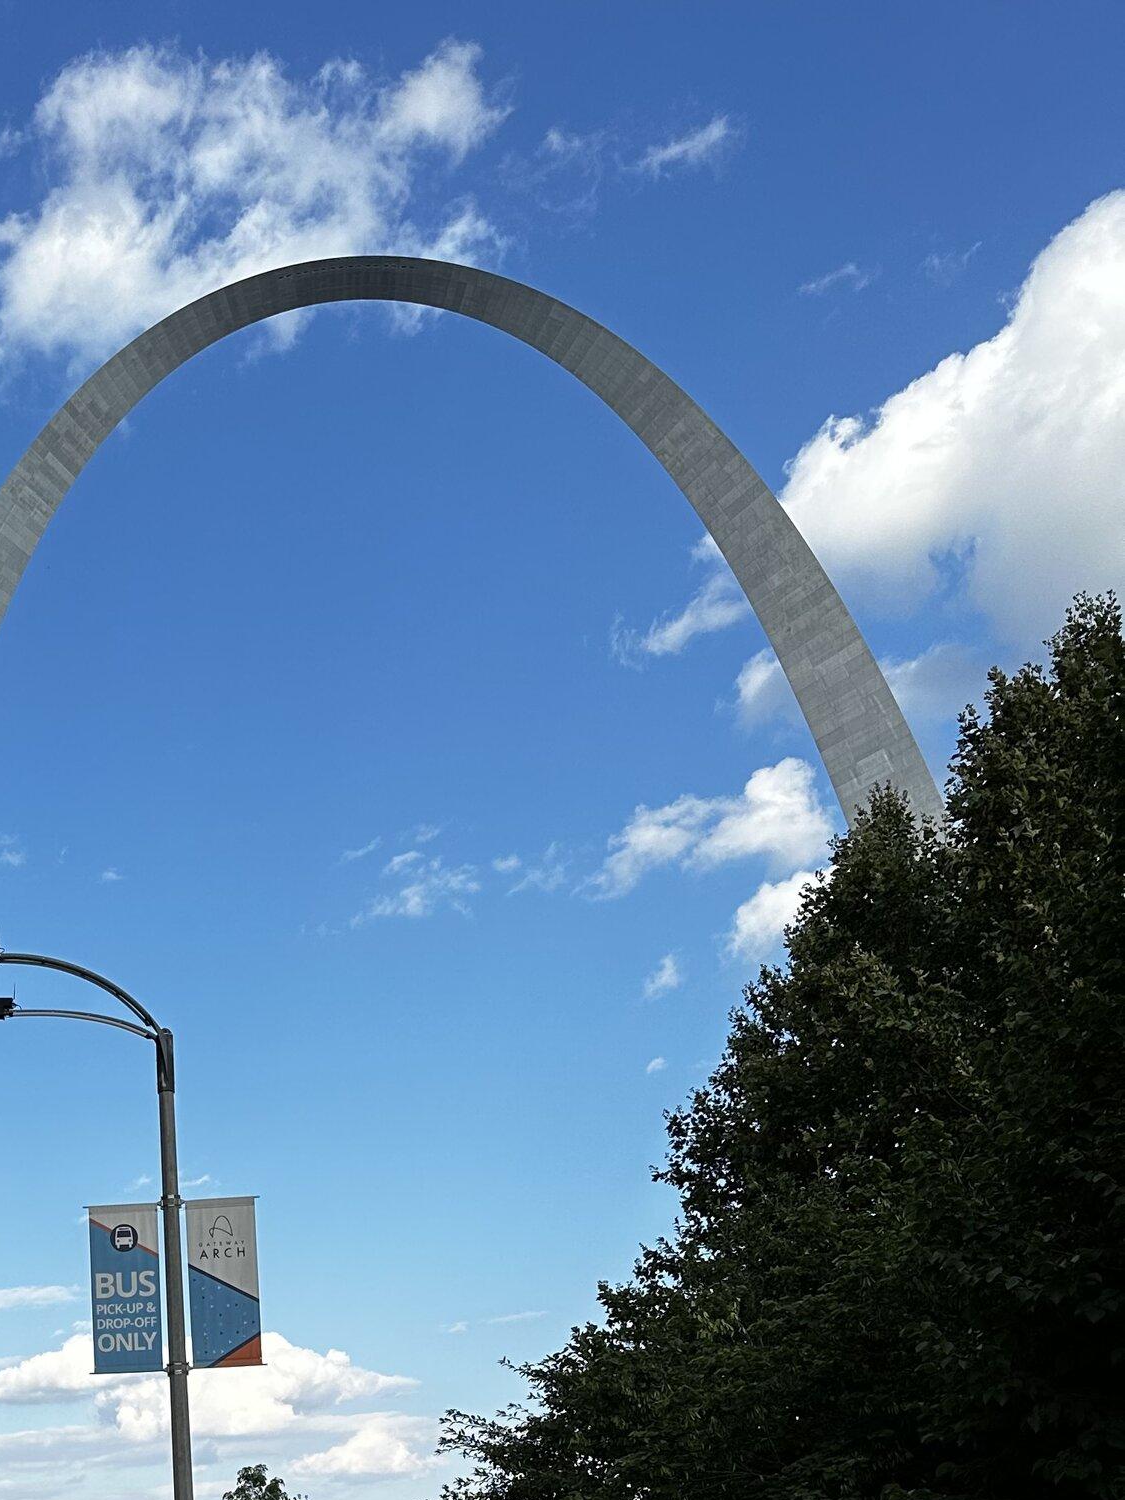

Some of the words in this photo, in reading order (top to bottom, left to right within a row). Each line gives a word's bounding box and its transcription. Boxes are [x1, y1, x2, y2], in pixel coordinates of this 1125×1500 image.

[198, 1240, 245, 1248] GATEWAY
[199, 1246, 246, 1260] ARCH
[95, 1270, 156, 1299] BUS
[96, 1303, 144, 1315] PICK-UP
[146, 1302, 157, 1313] &
[97, 1317, 158, 1330] DROP-OFF
[97, 1332, 158, 1352] ONLY
